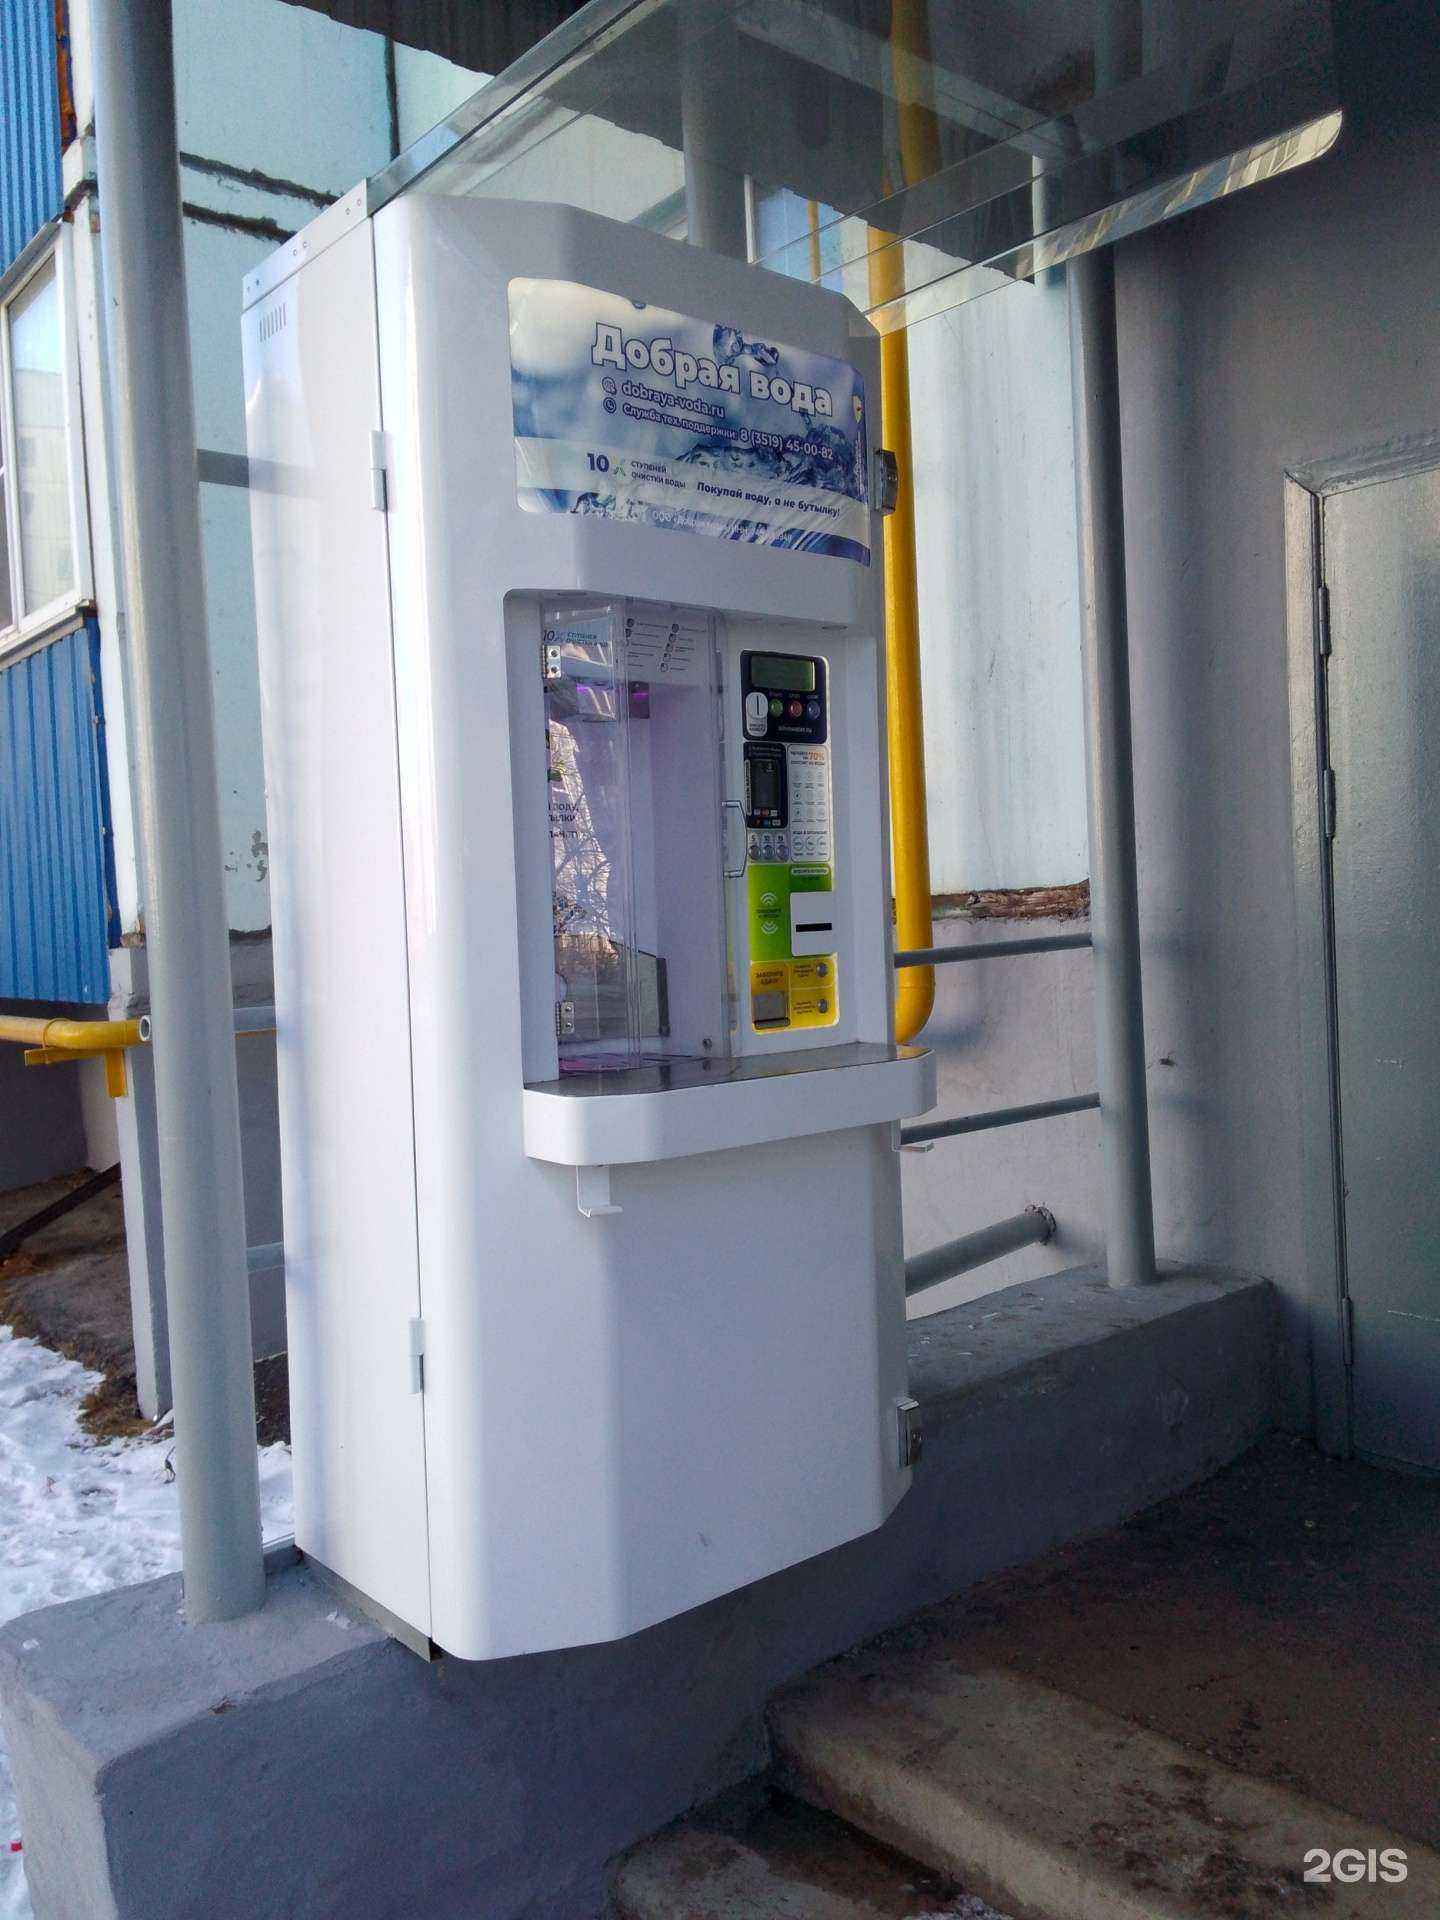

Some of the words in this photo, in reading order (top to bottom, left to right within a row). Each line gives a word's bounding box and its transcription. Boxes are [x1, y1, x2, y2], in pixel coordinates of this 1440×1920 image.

[591, 322, 741, 394] Добрая
[750, 370, 833, 417] вода
[621, 381, 725, 418] dobraya-voda.ru
[587, 452, 609, 473] 10
[740, 428, 749, 442] 8
[751, 429, 783, 451] (3519)
[785, 439, 834, 460] 45-00-82
[697, 481, 743, 499] Покупай
[745, 492, 772, 507] воду,
[774, 498, 781, 506] а
[783, 499, 796, 509] не
[798, 500, 841, 518] бутылку!
